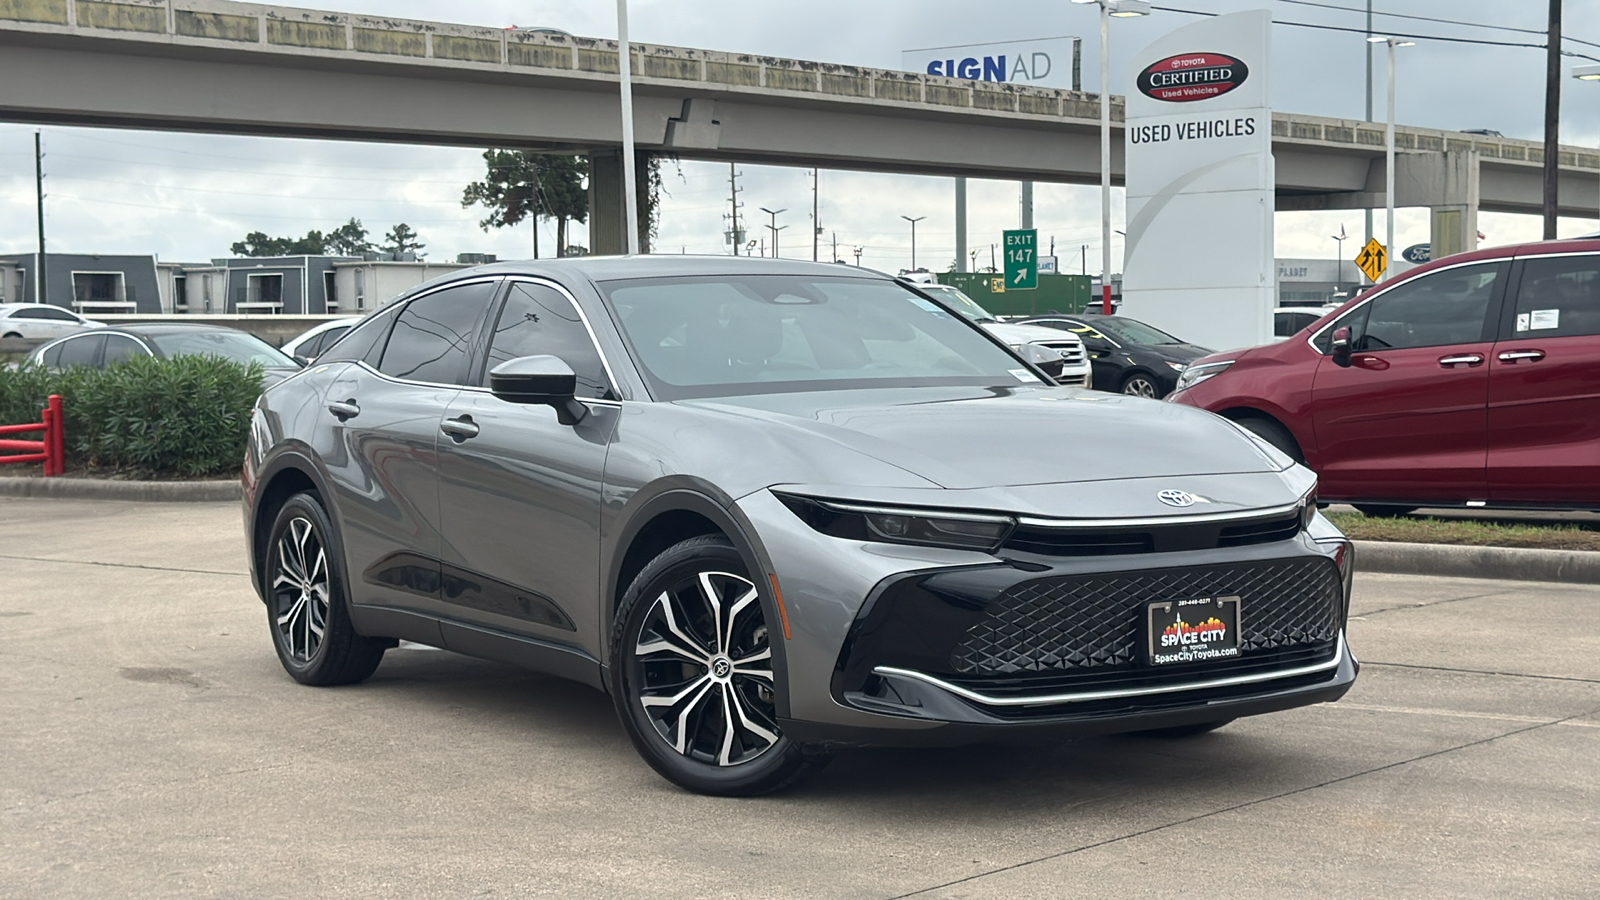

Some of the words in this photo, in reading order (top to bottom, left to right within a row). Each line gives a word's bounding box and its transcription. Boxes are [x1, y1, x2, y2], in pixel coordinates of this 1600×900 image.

[1180, 58, 1206, 67] TOYOTA
[1149, 68, 1232, 87] CERTIFIED
[1162, 89, 1182, 98] Used
[1183, 86, 1219, 96] Vehicles
[1131, 124, 1171, 144] USED
[1176, 117, 1255, 140] VEHICLES
[1007, 235, 1032, 245] EXIT
[1008, 249, 1033, 263] 147
[1410, 248, 1431, 260] For
[1161, 631, 1198, 646] SPACE
[1200, 629, 1226, 642] CITY
[1155, 647, 1238, 664] SpaceCityToyota.com
